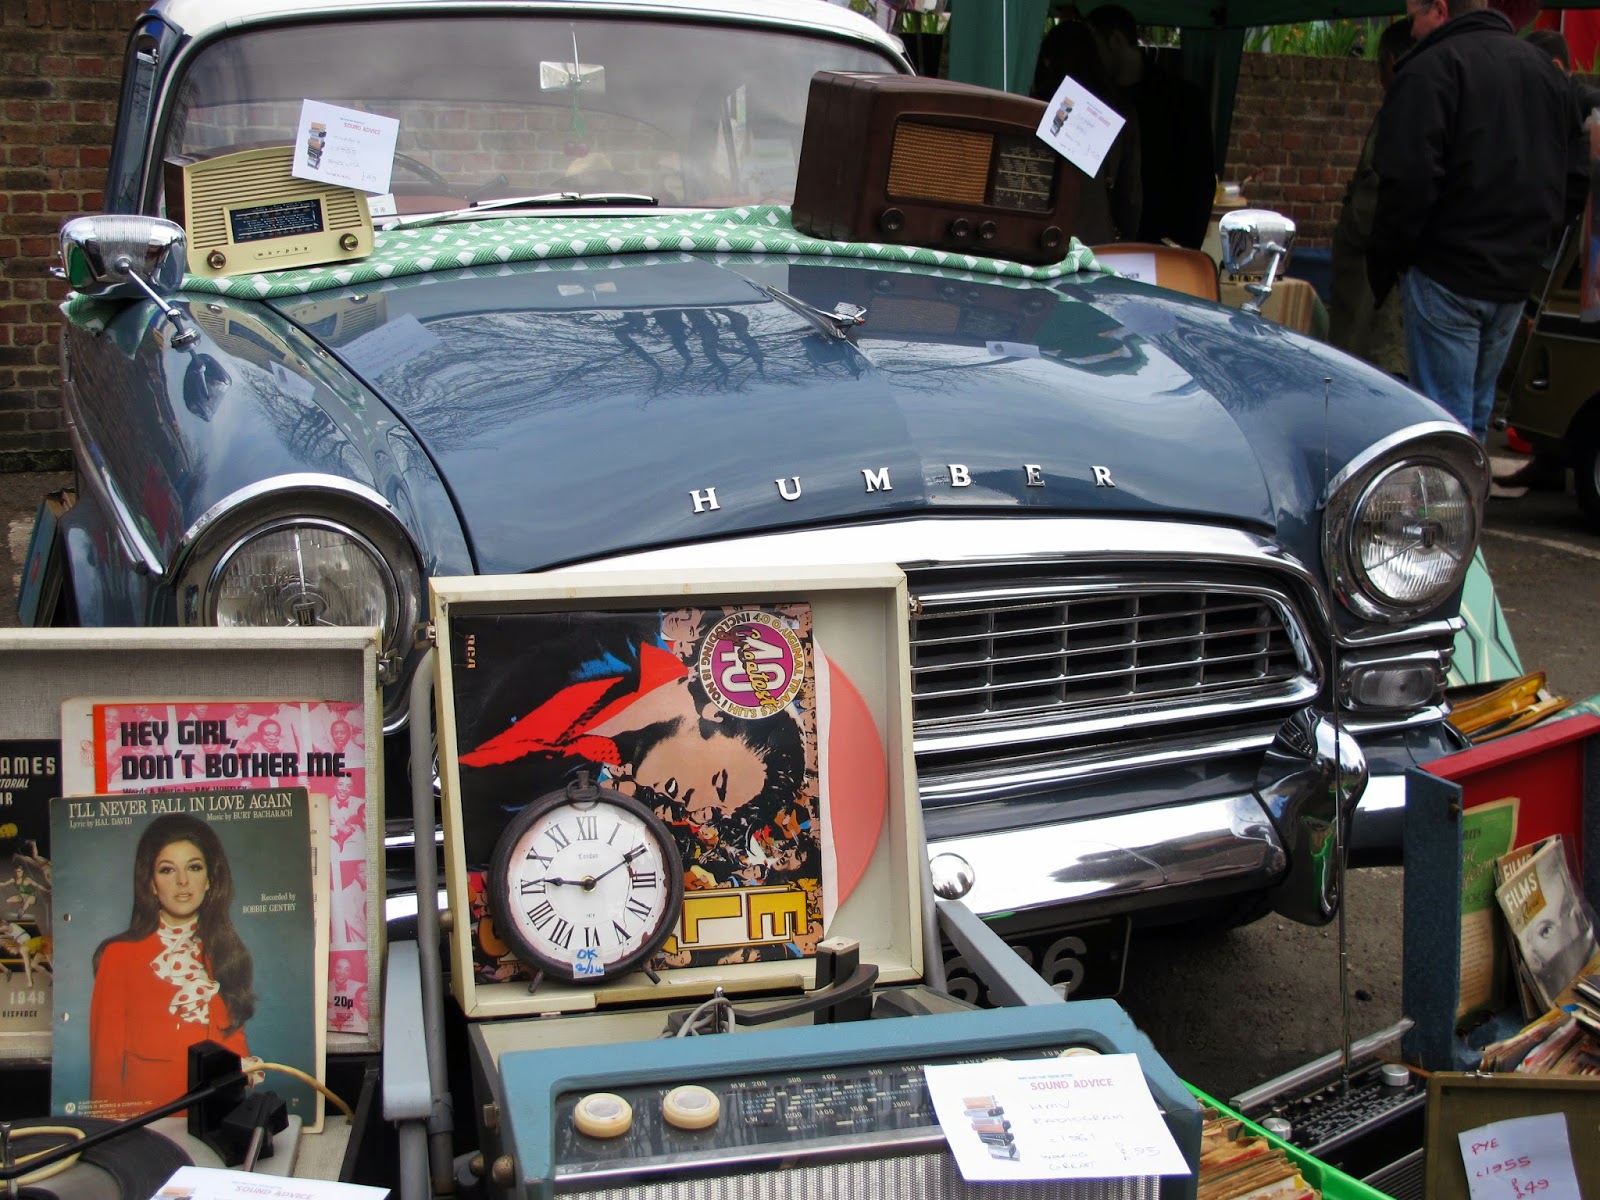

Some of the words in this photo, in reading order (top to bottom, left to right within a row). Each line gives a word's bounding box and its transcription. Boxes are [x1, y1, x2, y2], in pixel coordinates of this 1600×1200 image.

[344, 122, 362, 131] SOUND
[363, 126, 382, 135] ADVICE
[689, 464, 1116, 513] HUMBER
[752, 612, 771, 624] 40
[701, 612, 751, 667] INCLUDING
[465, 634, 476, 669] RCA
[701, 667, 712, 682] 18
[760, 677, 801, 718] TRACKS
[727, 703, 758, 719] HITS
[121, 720, 169, 747] HEY
[177, 719, 239, 749] GIRL,
[0, 756, 56, 775] AMES
[205, 752, 300, 778] BOTHER
[0, 778, 30, 788] TORIAL
[69, 802, 96, 818] I'LL
[100, 800, 147, 817] NEVER
[151, 798, 185, 814] FALL
[189, 796, 205, 812] IN
[209, 794, 245, 811] LOVE
[249, 792, 292, 809] AGAIN
[206, 813, 224, 821] Music
[225, 812, 232, 821] by
[233, 811, 251, 820] BURT
[253, 809, 293, 818] BACHARACH
[70, 820, 86, 829] Lyric
[87, 820, 94, 828] by
[95, 818, 110, 826] HAL
[112, 817, 133, 825] DAVID
[261, 892, 288, 901] Recorded
[288, 892, 296, 900] by
[1505, 872, 1538, 914] FILMS
[242, 904, 267, 913] BOBBIE
[269, 903, 297, 912] GENTRY
[576, 949, 599, 960] OK
[334, 995, 354, 1010] 20p
[1030, 1080, 1069, 1091] SOUND
[1073, 1078, 1114, 1089] ADVICE
[1033, 1113, 1124, 1124] RADIOGRAM
[1471, 1138, 1499, 1155] PYE
[235, 1185, 272, 1195] SOUND
[275, 1191, 314, 1200] ADVICE
[1511, 1177, 1550, 1199] £49
